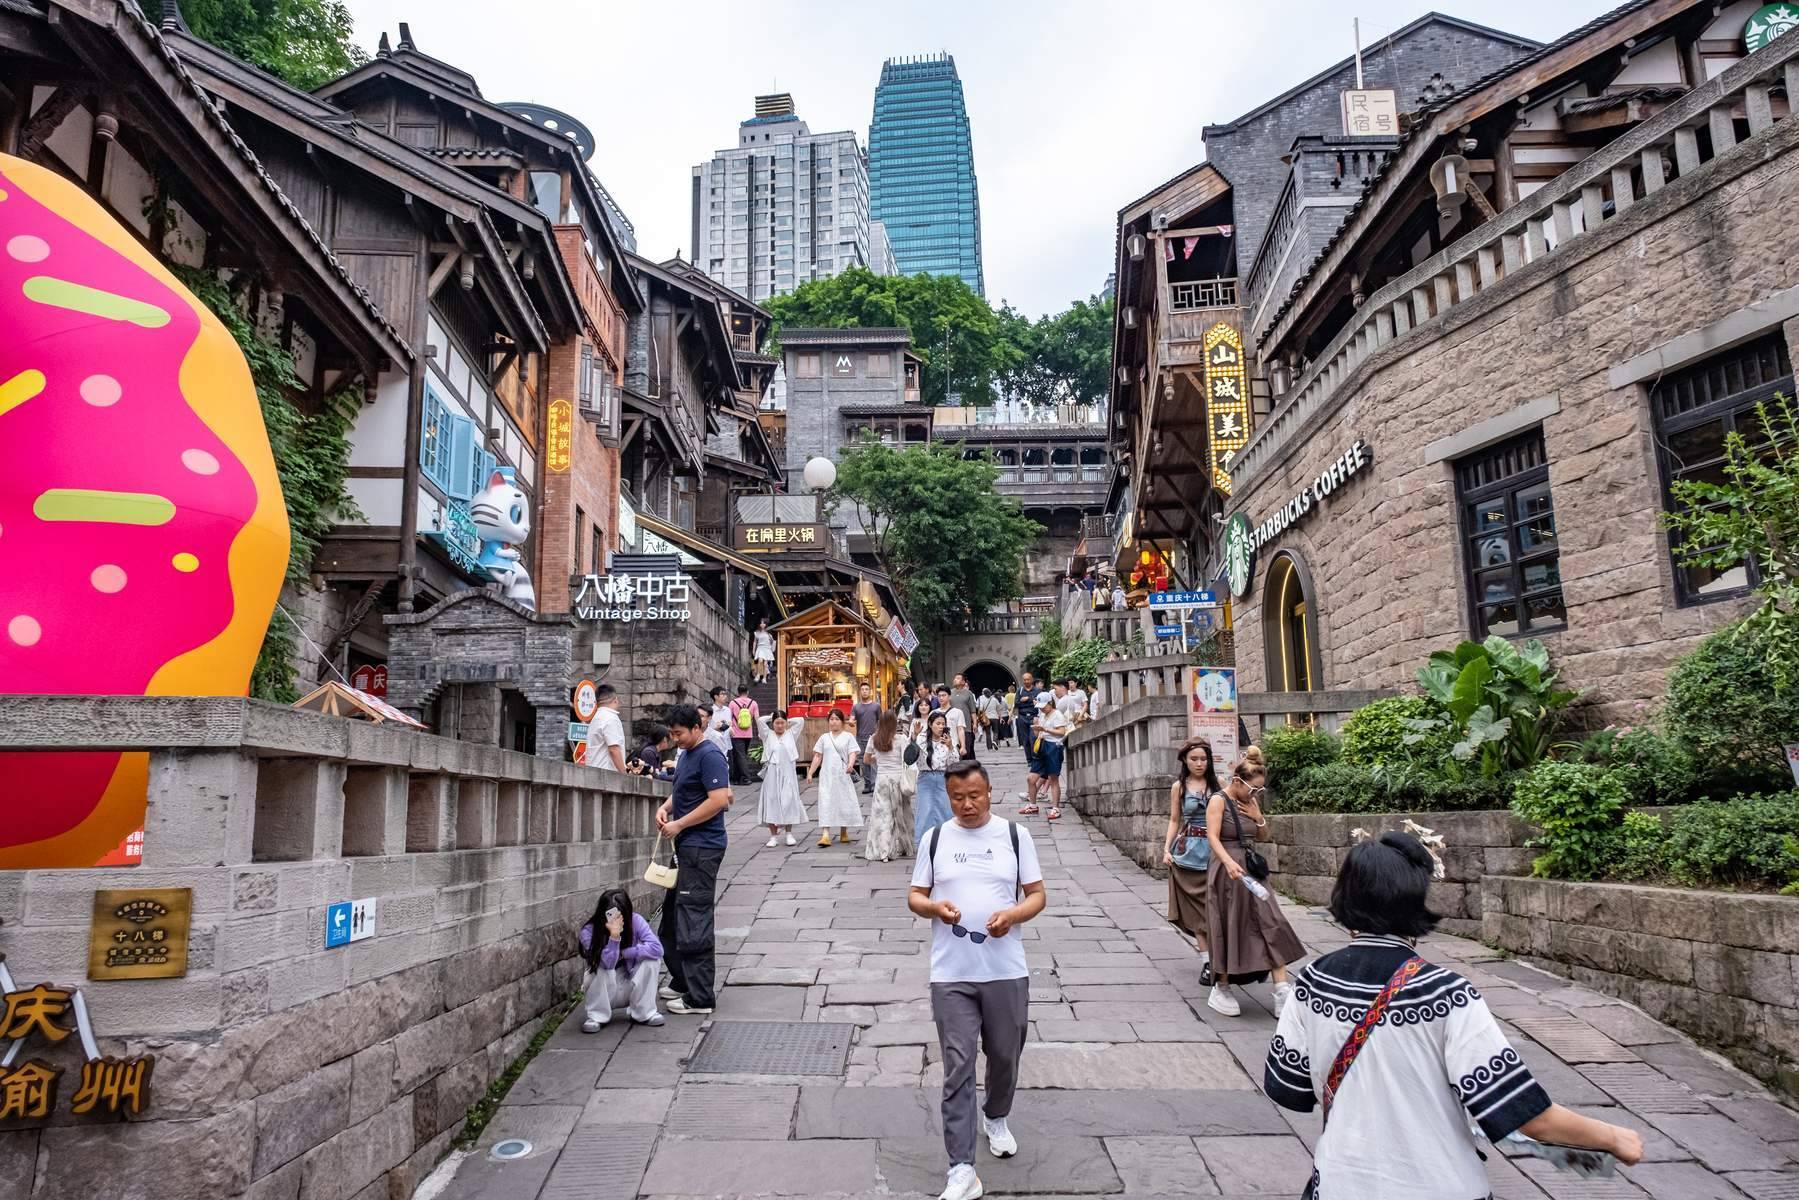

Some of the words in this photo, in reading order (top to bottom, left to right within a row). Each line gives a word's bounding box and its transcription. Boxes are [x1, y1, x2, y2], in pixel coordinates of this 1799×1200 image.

[1248, 487, 1310, 553] STARBUCKS
[1313, 440, 1365, 501] COFFEE
[746, 527, 815, 543] 在渝里火锅
[575, 571, 692, 604] 八幡中古
[1166, 592, 1209, 602] 重庆十八梯
[577, 606, 642, 622] Vintage
[646, 606, 691, 622] Shop
[0, 984, 72, 1041] 庆
